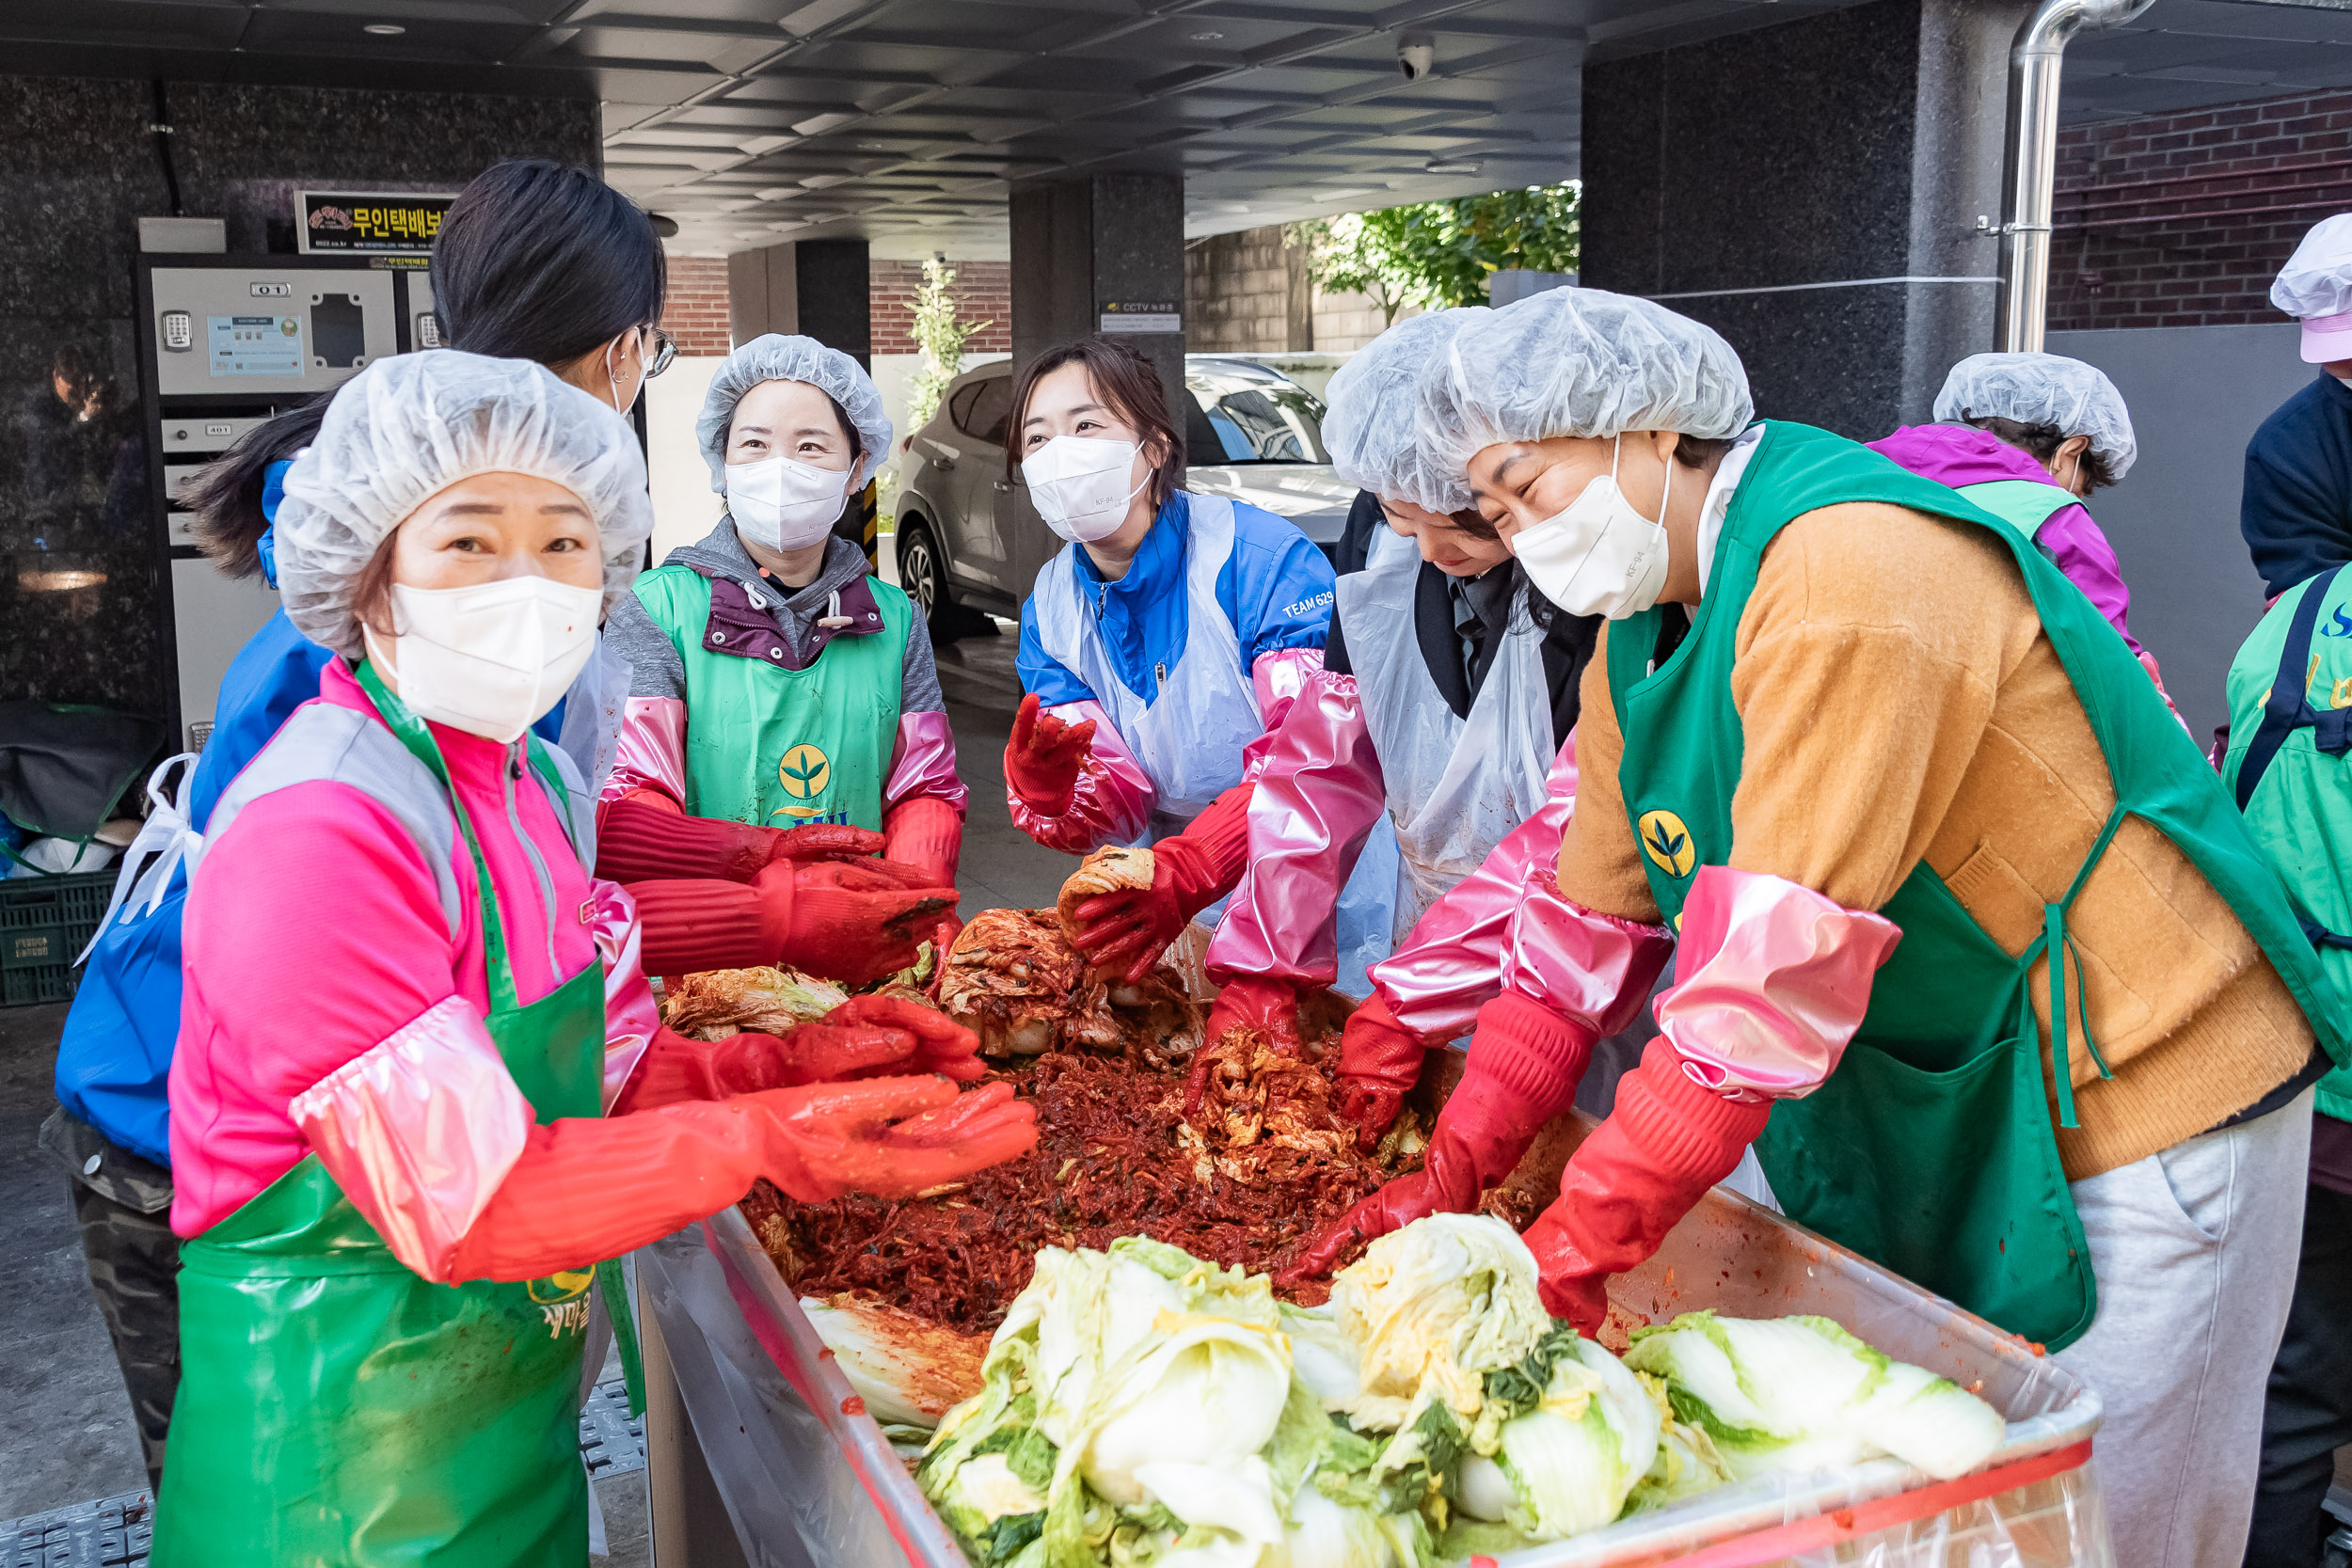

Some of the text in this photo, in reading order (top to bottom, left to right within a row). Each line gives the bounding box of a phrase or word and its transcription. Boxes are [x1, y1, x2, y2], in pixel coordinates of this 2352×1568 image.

[354, 208, 449, 238] 무인택배보
[259, 286, 280, 294] 01
[1123, 302, 1149, 311] CCTV
[1625, 551, 1645, 578] KF-94
[1281, 591, 1334, 618] TEAM 629
